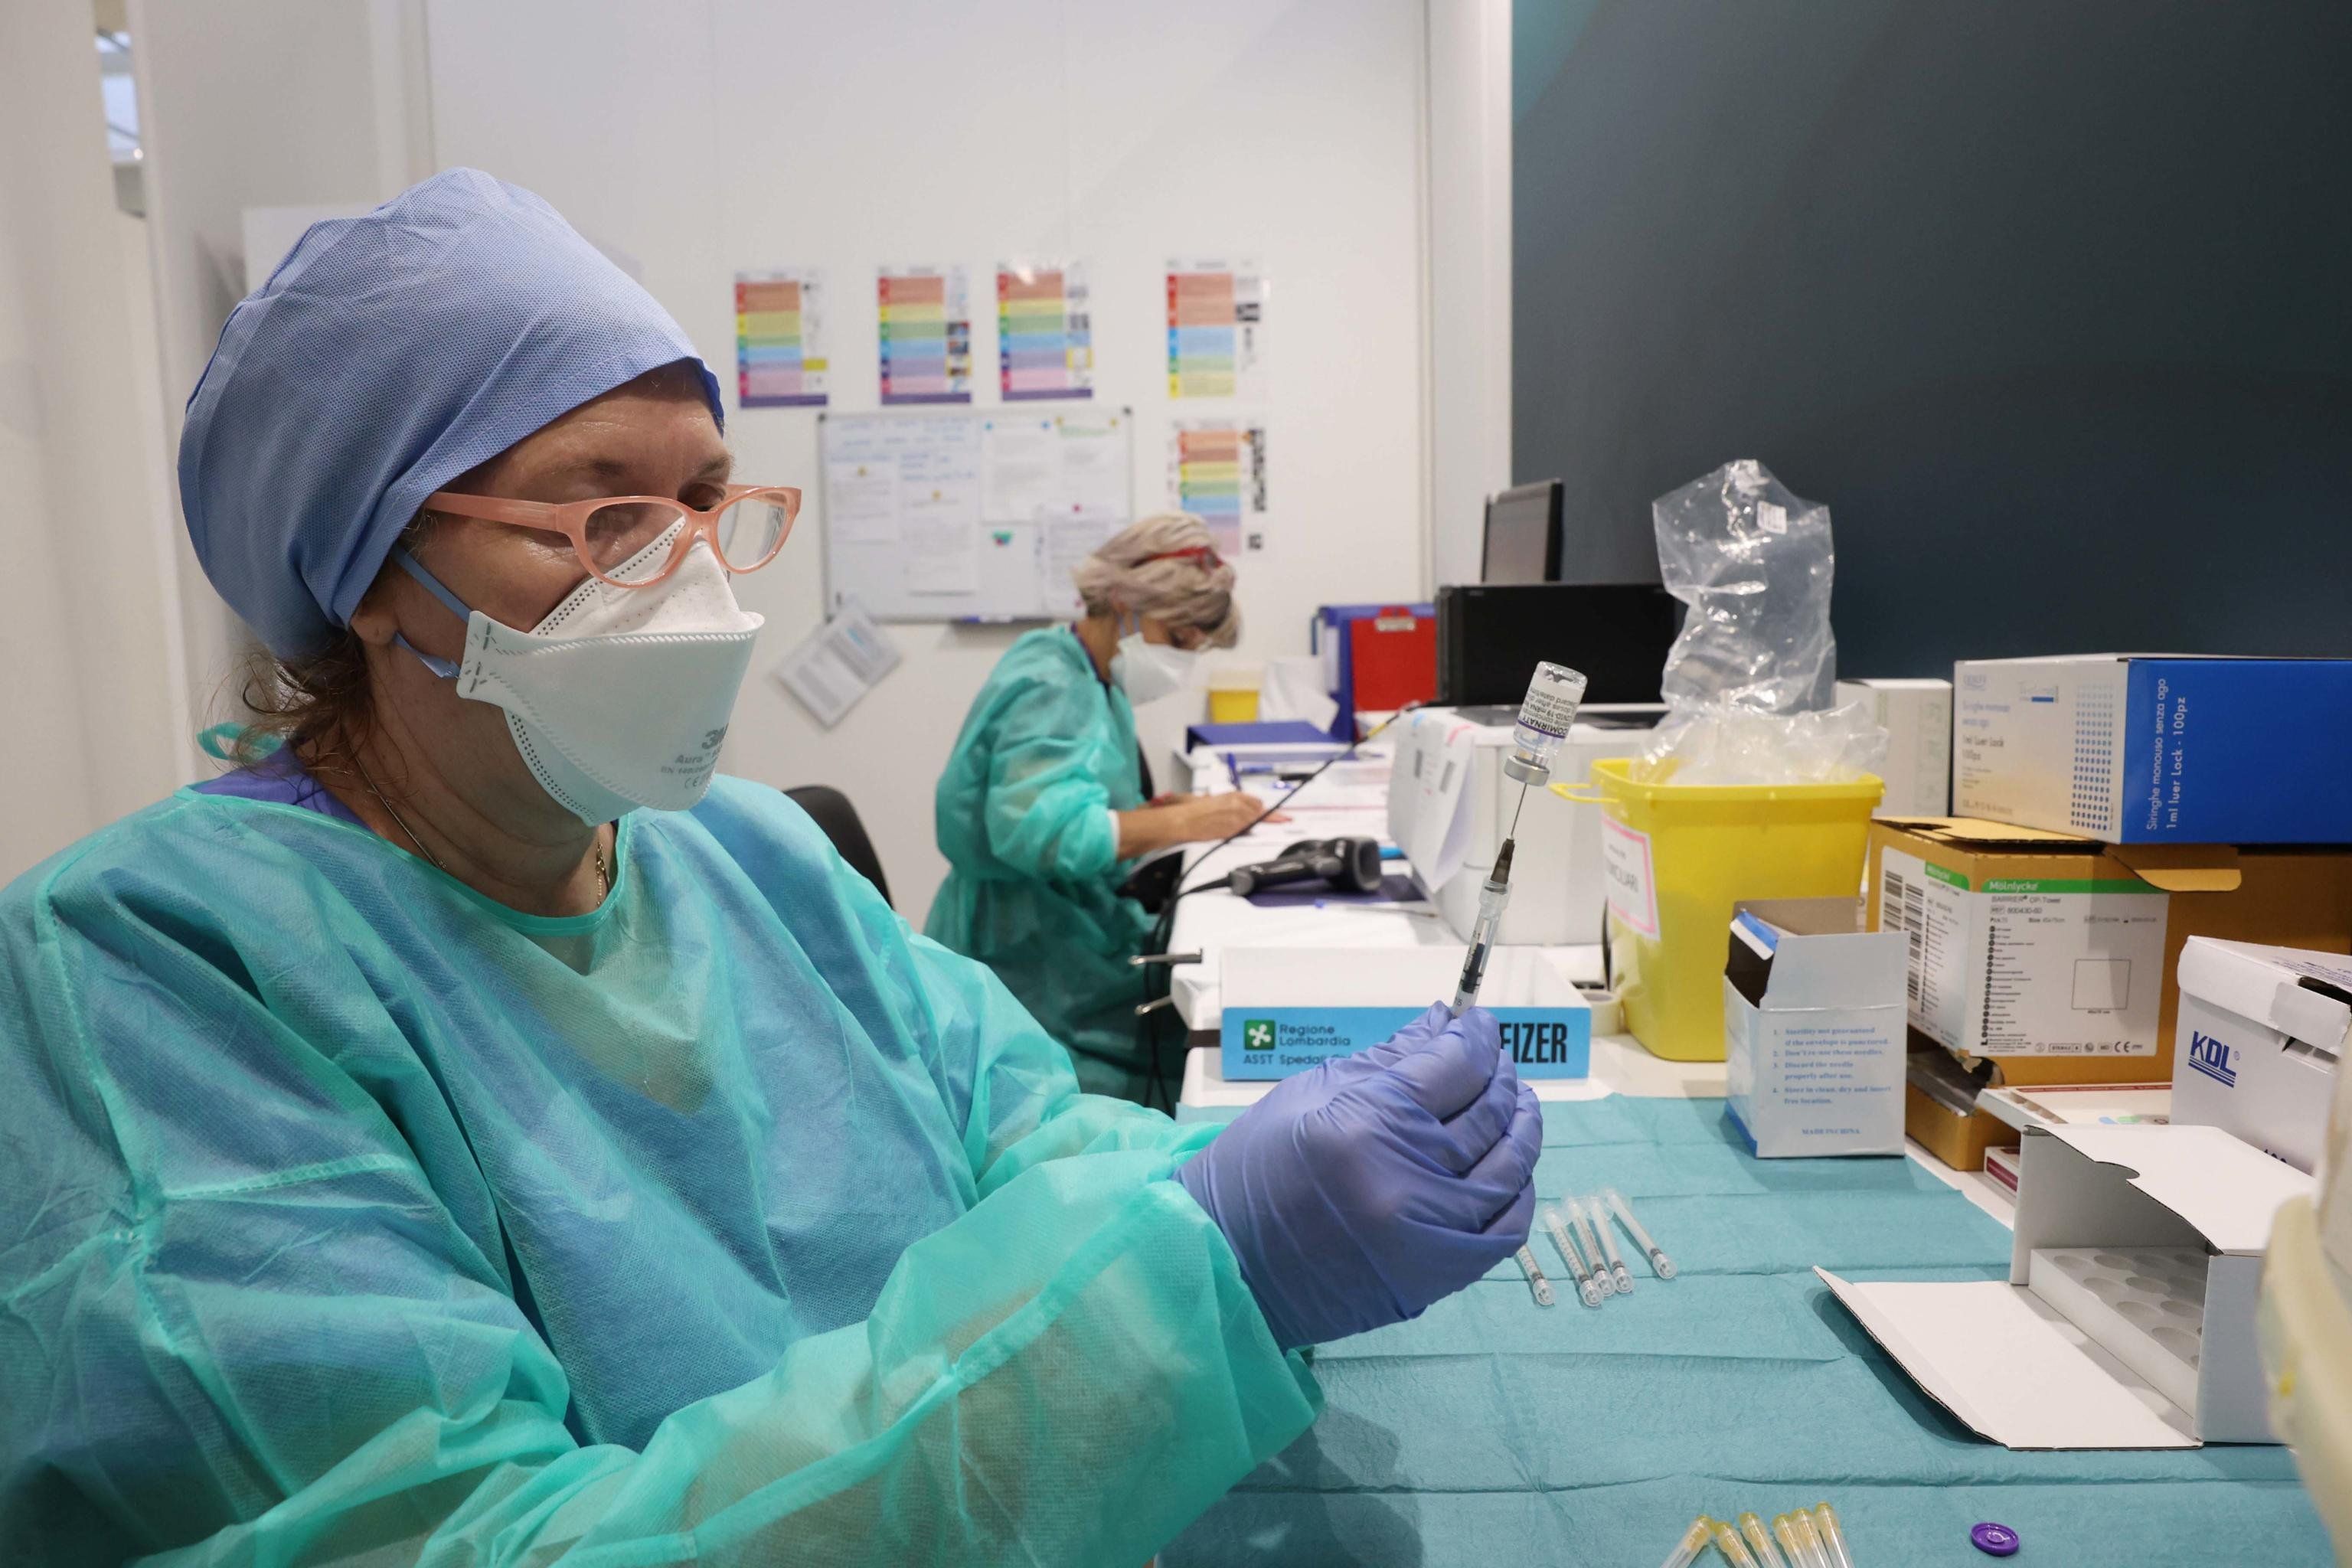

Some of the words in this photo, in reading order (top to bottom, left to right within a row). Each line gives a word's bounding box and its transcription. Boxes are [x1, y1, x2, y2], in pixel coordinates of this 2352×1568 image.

[2157, 678, 2169, 701] ago
[2154, 704, 2165, 734] senza
[2172, 697, 2188, 736] 100pz
[675, 754, 704, 764] Aura
[2152, 737, 2164, 784] monouso
[2171, 749, 2184, 776] Lock
[2167, 780, 2180, 804] luer
[2146, 788, 2162, 830] Siringhe
[1279, 1024, 1335, 1036] Regione
[1279, 1037, 1351, 1047] Lombardia
[1498, 1022, 1567, 1063] FIZER
[1832, 1027, 1875, 1035] guaranteed
[1243, 1054, 1273, 1064] ASST
[2190, 1031, 2236, 1076] KDL
